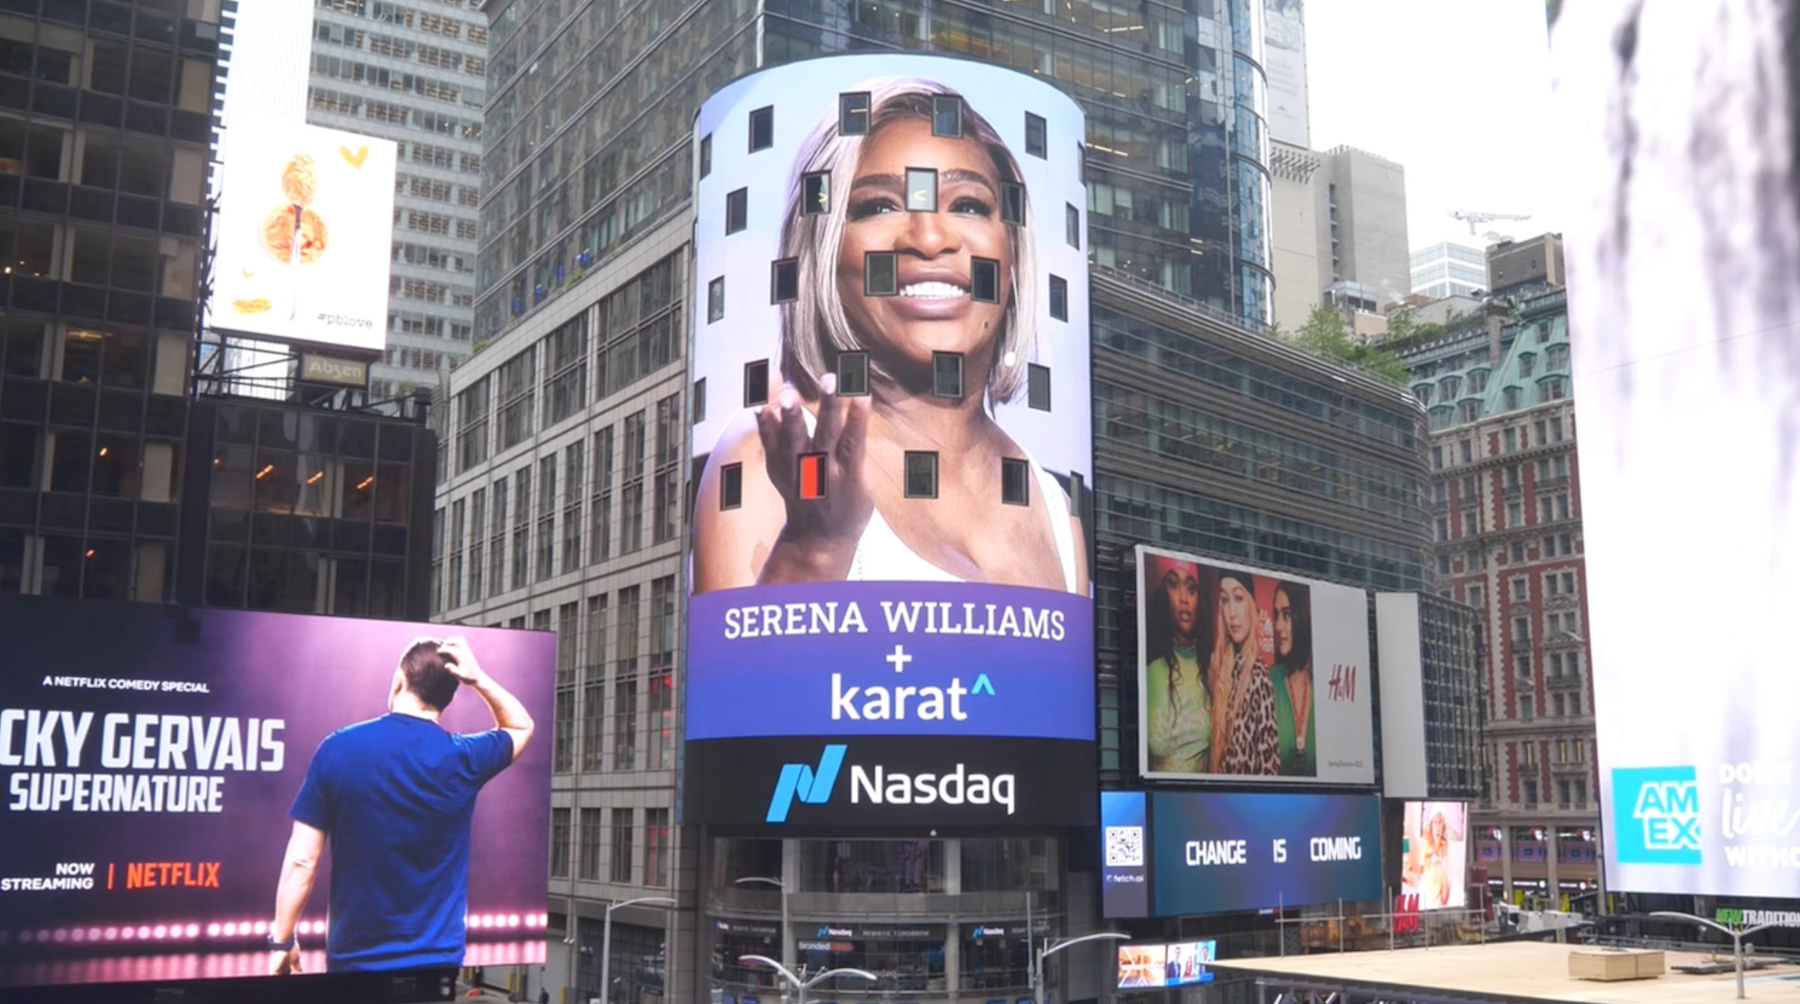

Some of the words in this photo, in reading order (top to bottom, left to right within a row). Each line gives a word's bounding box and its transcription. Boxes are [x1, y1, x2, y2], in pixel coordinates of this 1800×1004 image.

[317, 313, 373, 329] #pblove
[308, 360, 362, 379] Absen
[724, 601, 868, 640] SERENA
[880, 601, 1066, 641] WILLIAMS
[42, 676, 53, 686] A
[54, 676, 107, 689] NETFLIX
[108, 679, 160, 692] COMEDY
[161, 681, 210, 693] SPECIAL
[1328, 664, 1357, 703] H&M
[0, 709, 95, 767] CKY
[101, 713, 286, 772] GERVAIS
[9, 772, 225, 813] SUPERNATURE
[850, 764, 1016, 816] Nasdaq
[1185, 840, 1247, 866] CHANGE
[1273, 839, 1287, 863] IS
[1310, 837, 1361, 861] COMING
[55, 863, 95, 876] NOW
[126, 862, 220, 889] NETFLIX
[1113, 874, 1144, 883] fetch.ai
[0, 877, 94, 891] STREAMING
[828, 927, 852, 936] Nasdaq
